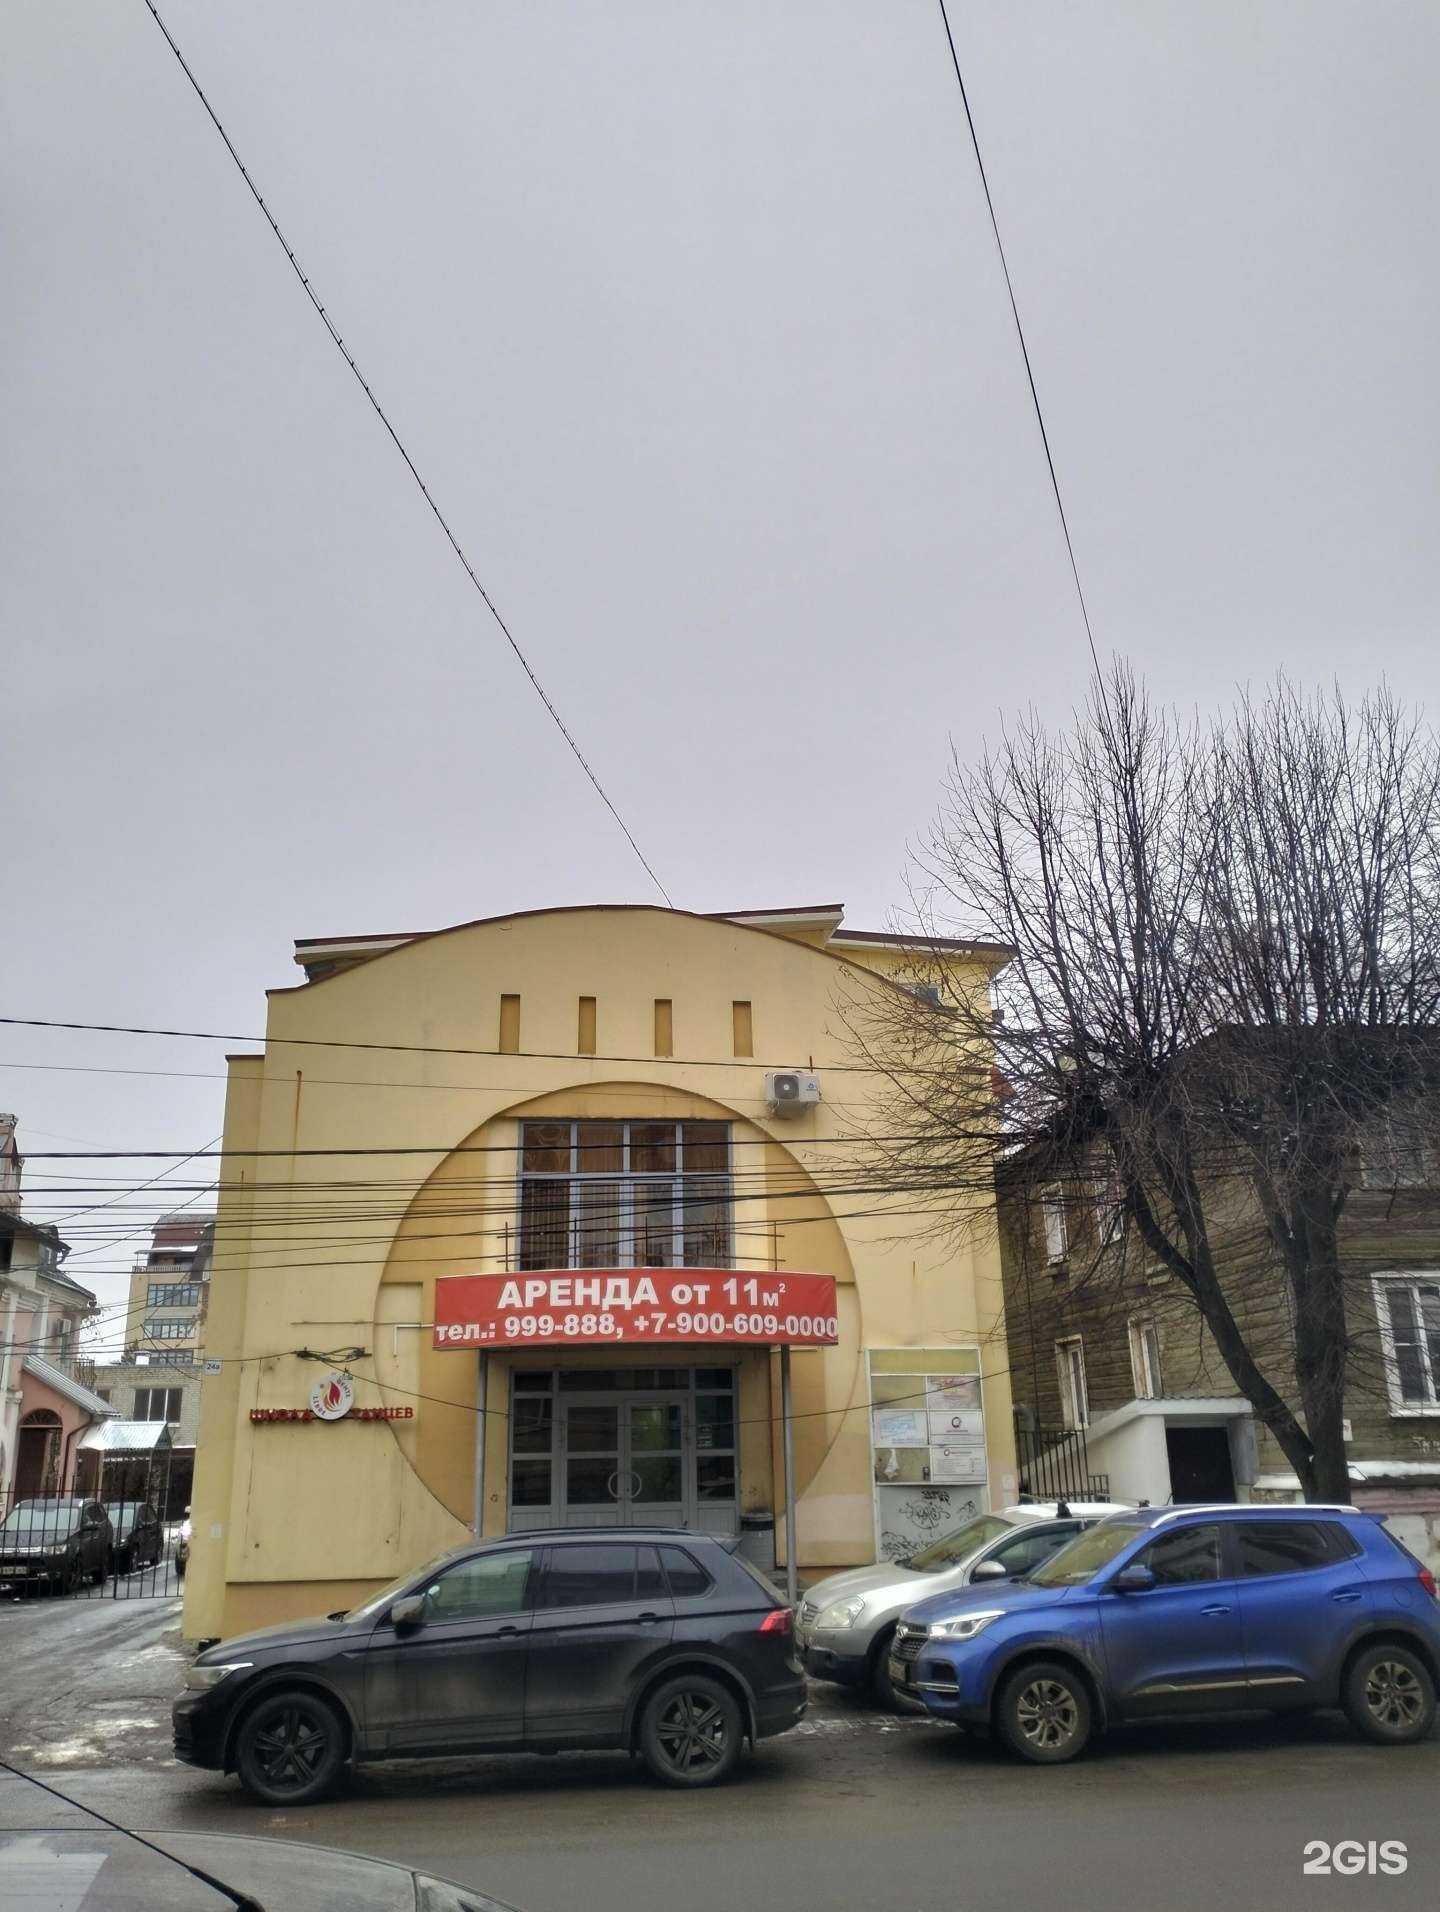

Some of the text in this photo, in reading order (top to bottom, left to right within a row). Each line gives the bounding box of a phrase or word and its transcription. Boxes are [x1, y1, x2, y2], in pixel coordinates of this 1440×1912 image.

[497, 1277, 660, 1311] АРЕНДА
[436, 1312, 838, 1341] тел.: 999-888, +7-900-609-0000
